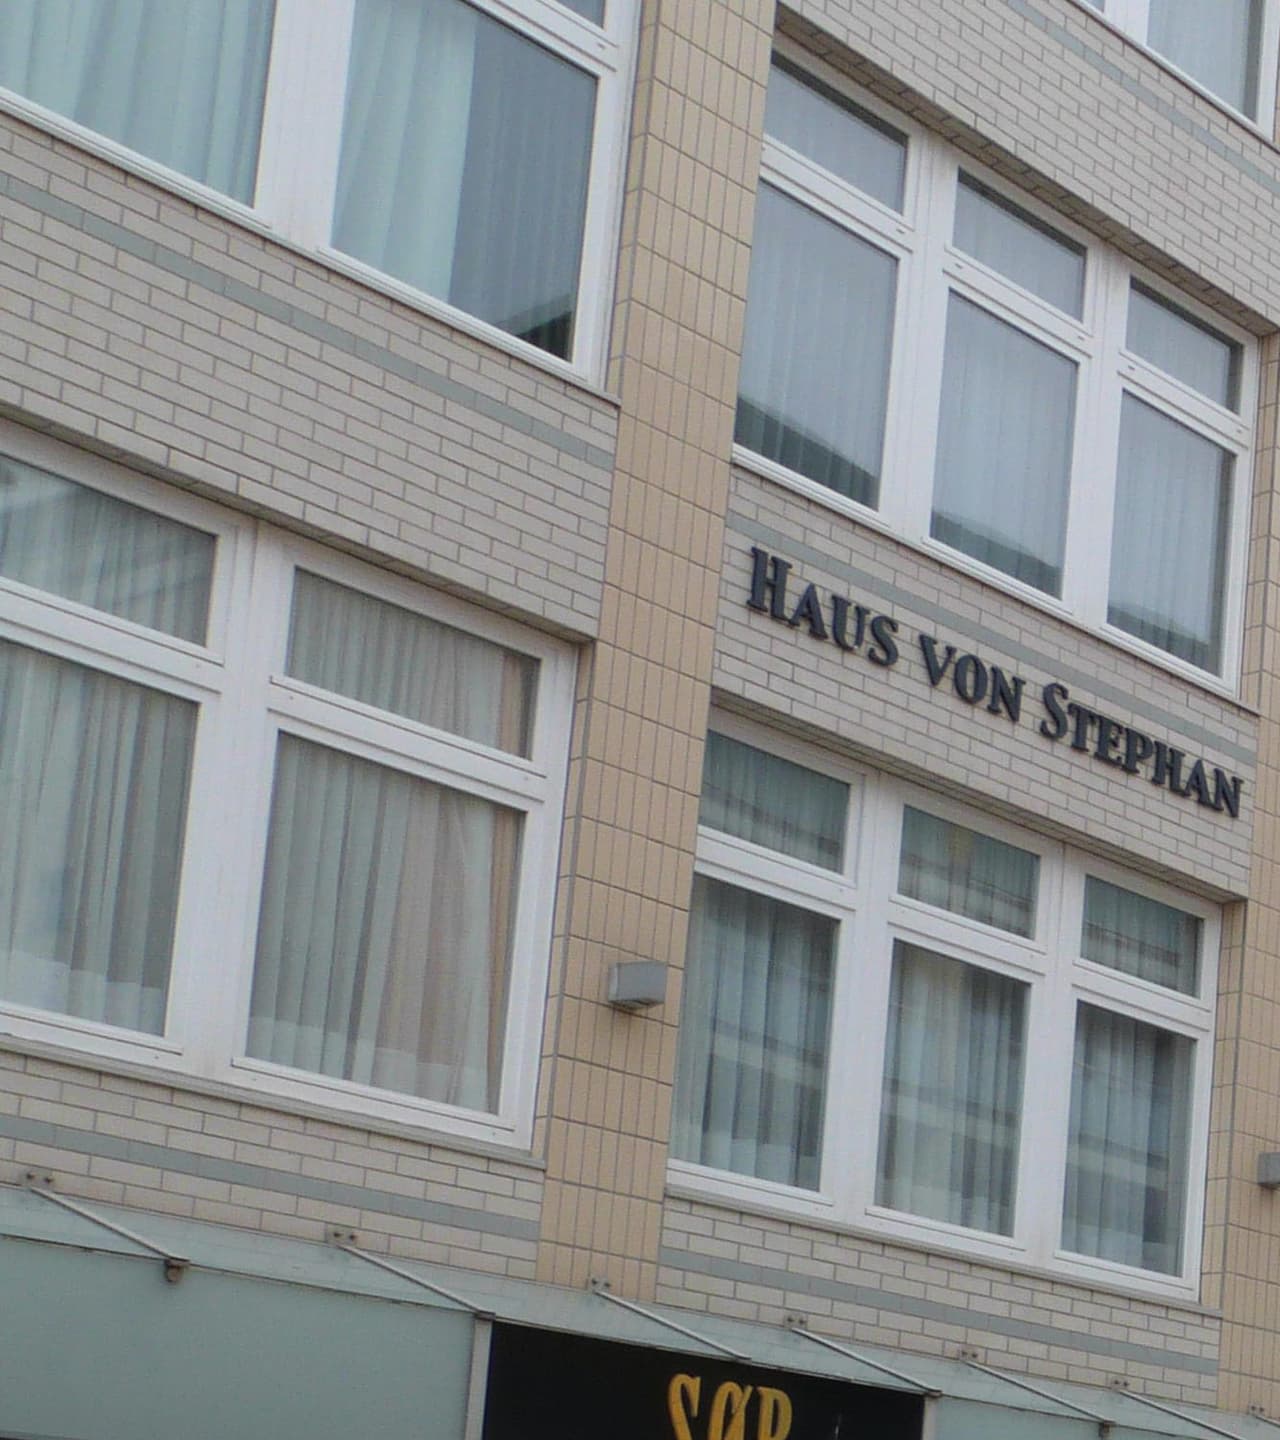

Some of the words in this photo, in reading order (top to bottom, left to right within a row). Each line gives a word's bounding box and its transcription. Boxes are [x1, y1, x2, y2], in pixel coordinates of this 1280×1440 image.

[747, 546, 900, 667] HAUS
[919, 632, 1026, 723] VON
[1039, 681, 1245, 819] STEPHAN
